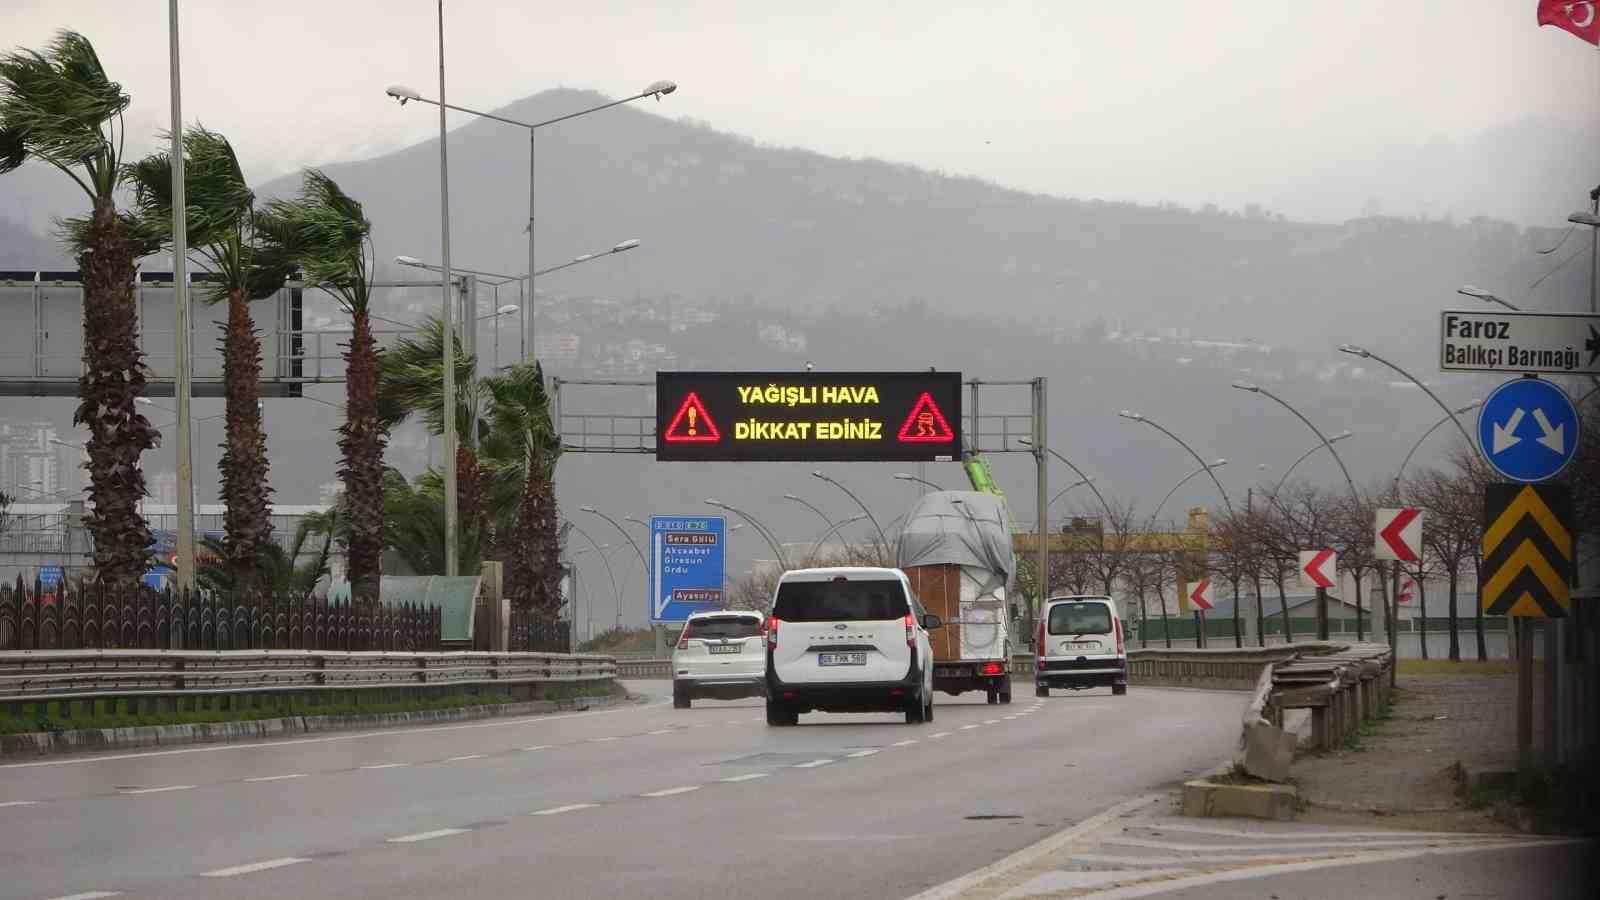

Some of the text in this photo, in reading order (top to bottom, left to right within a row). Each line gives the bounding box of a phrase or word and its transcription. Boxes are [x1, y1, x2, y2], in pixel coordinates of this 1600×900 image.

[1447, 316, 1510, 339] Faroz
[1445, 344, 1580, 370] Balıkçı Barınağı
[737, 384, 879, 406] YAĞIŞLI HAVA
[735, 418, 882, 440] DİKKAT EDİNİZ
[667, 534, 689, 543] Sera
[664, 556, 703, 564] Giresun
[664, 566, 688, 574] Ordu
